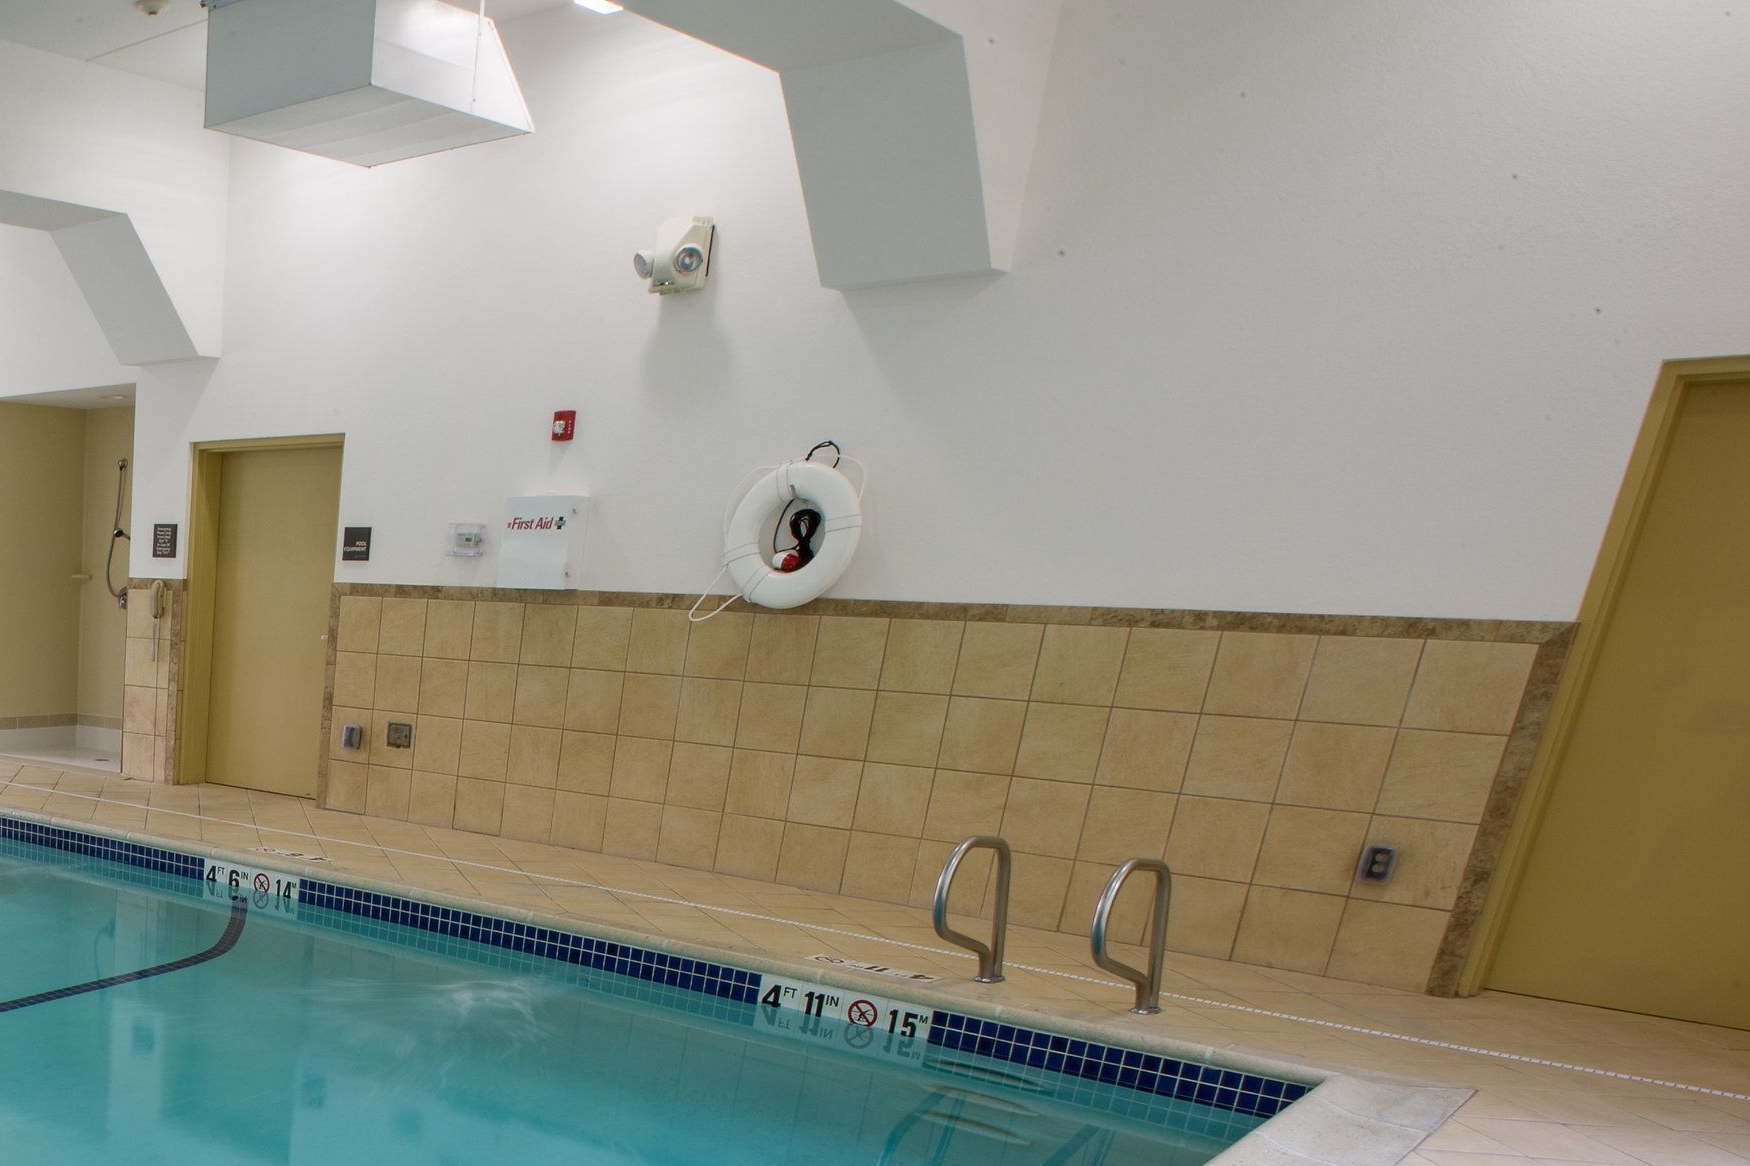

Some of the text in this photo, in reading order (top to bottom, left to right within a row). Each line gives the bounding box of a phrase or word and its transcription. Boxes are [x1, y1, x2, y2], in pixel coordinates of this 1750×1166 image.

[511, 516, 554, 530] First Aid
[206, 865, 249, 888] 4 FT 6 IN
[761, 984, 840, 1018] 4 FT 11 IN
